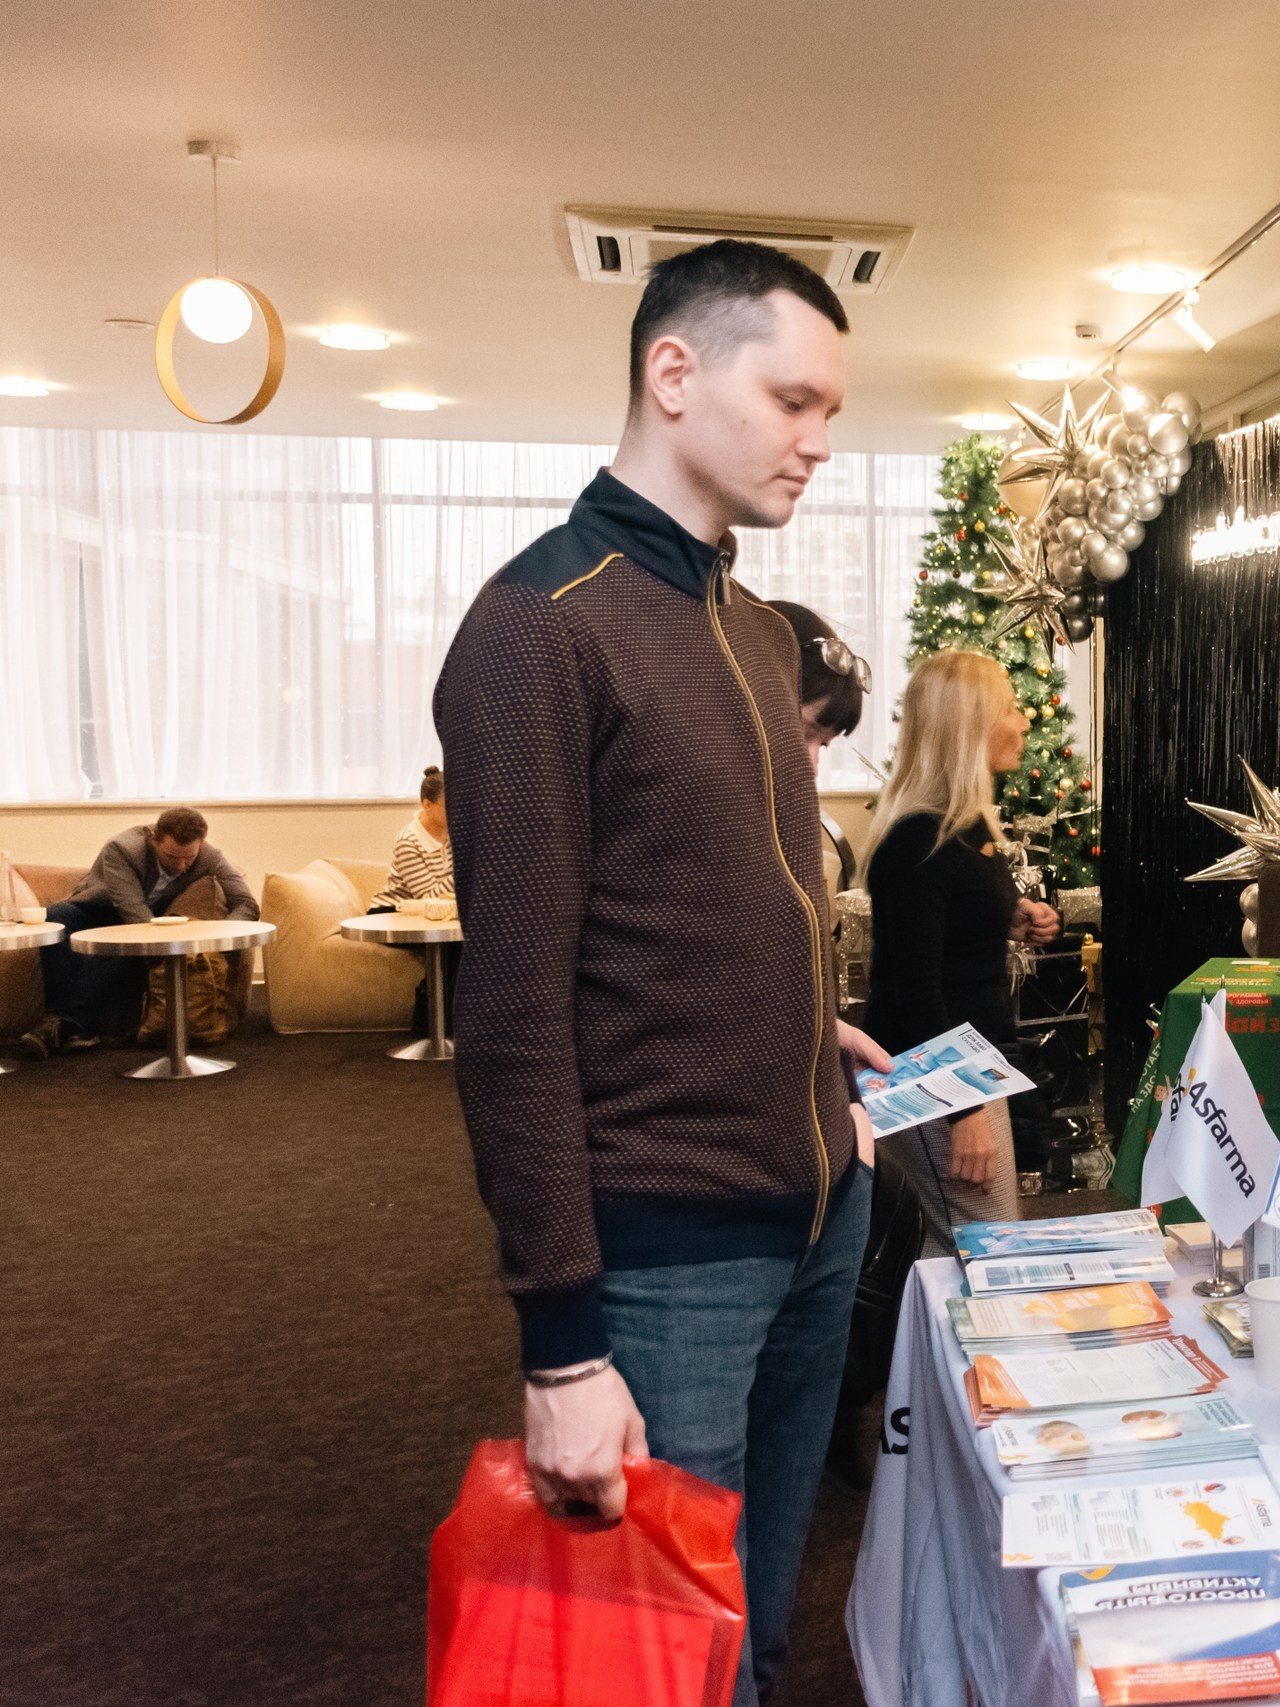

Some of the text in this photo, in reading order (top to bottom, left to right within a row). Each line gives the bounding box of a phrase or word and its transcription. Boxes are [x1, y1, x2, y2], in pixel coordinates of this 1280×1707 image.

[1189, 1081, 1256, 1198] Asfarma
[1128, 1577, 1262, 1594] АКТИВНЫМ
[1096, 1589, 1266, 1610] ПРОСТО БЫТЬ
